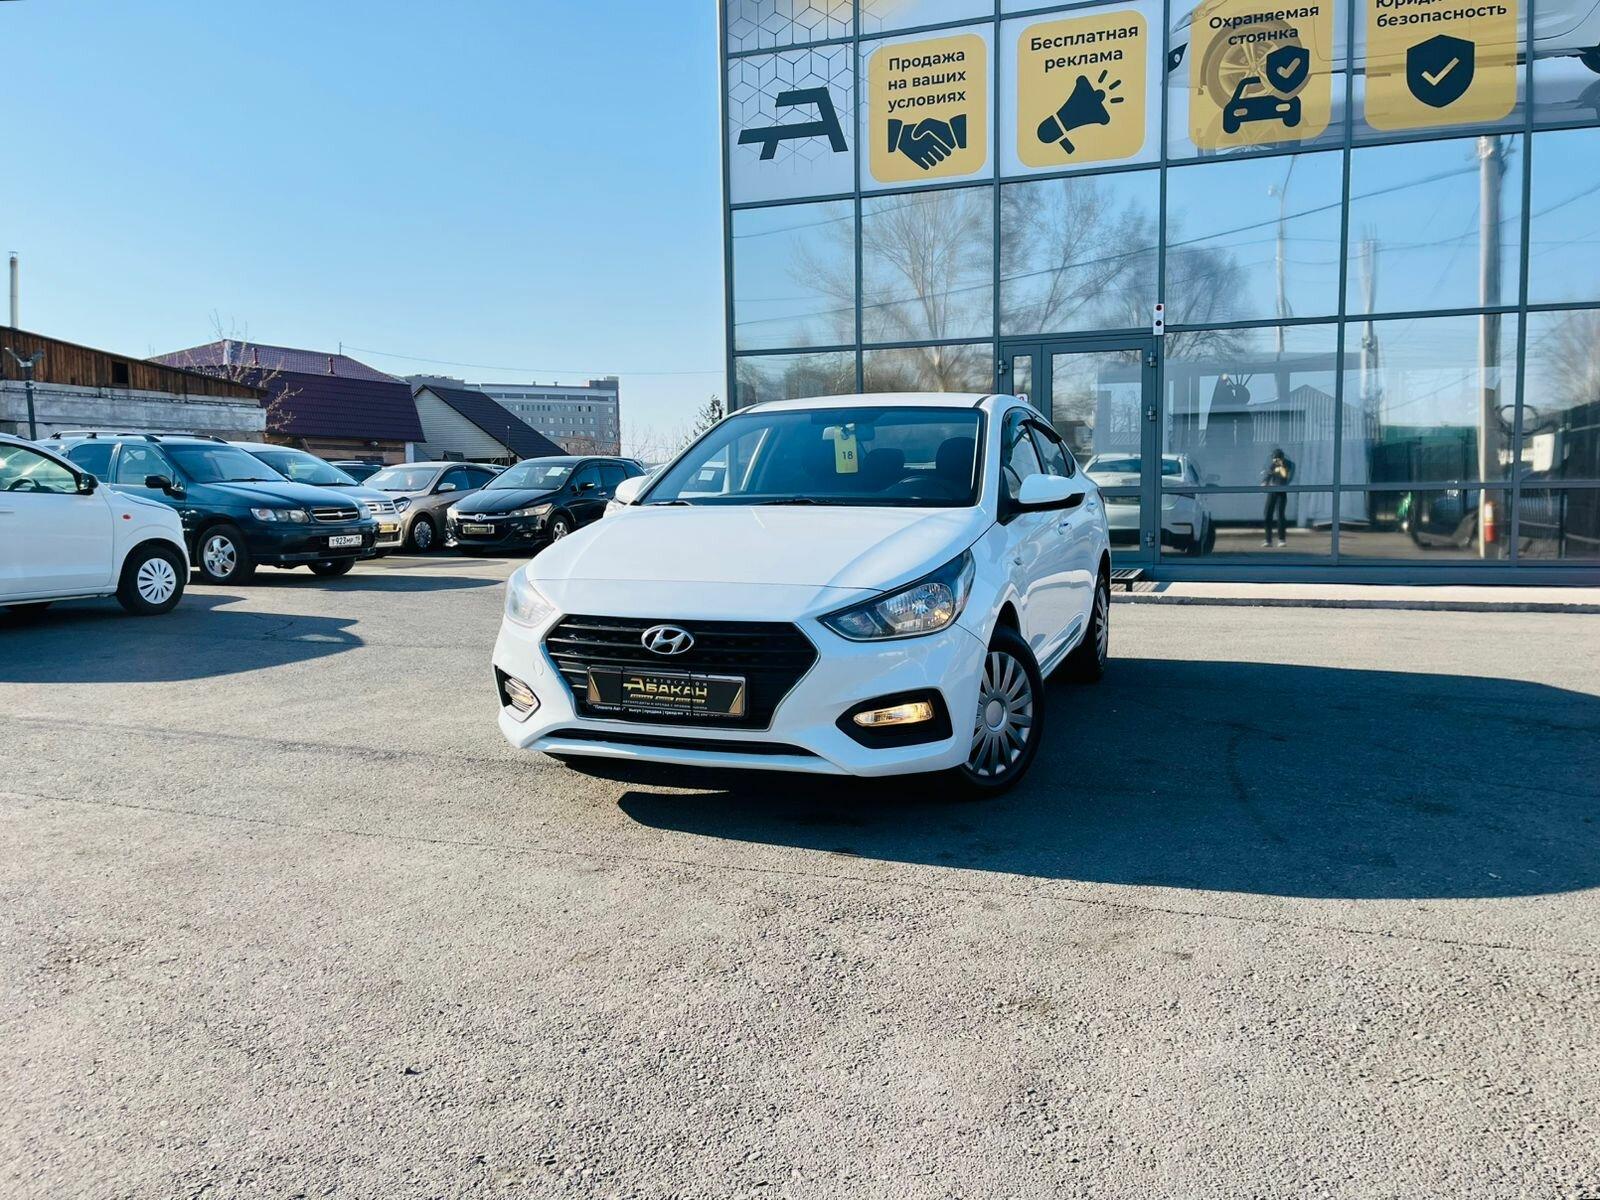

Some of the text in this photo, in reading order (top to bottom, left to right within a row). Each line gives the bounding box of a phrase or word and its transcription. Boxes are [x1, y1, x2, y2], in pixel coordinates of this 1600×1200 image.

[1209, 6, 1319, 29] Охраняемая
[1377, 5, 1507, 27] безопасность
[1030, 26, 1138, 51] Бесплатная
[1228, 28, 1299, 45] стоянка
[888, 51, 965, 72] Продажа
[1045, 49, 1123, 73] реклама
[888, 71, 966, 90] на ваших
[887, 91, 966, 113] условиях
[842, 450, 854, 460] 18
